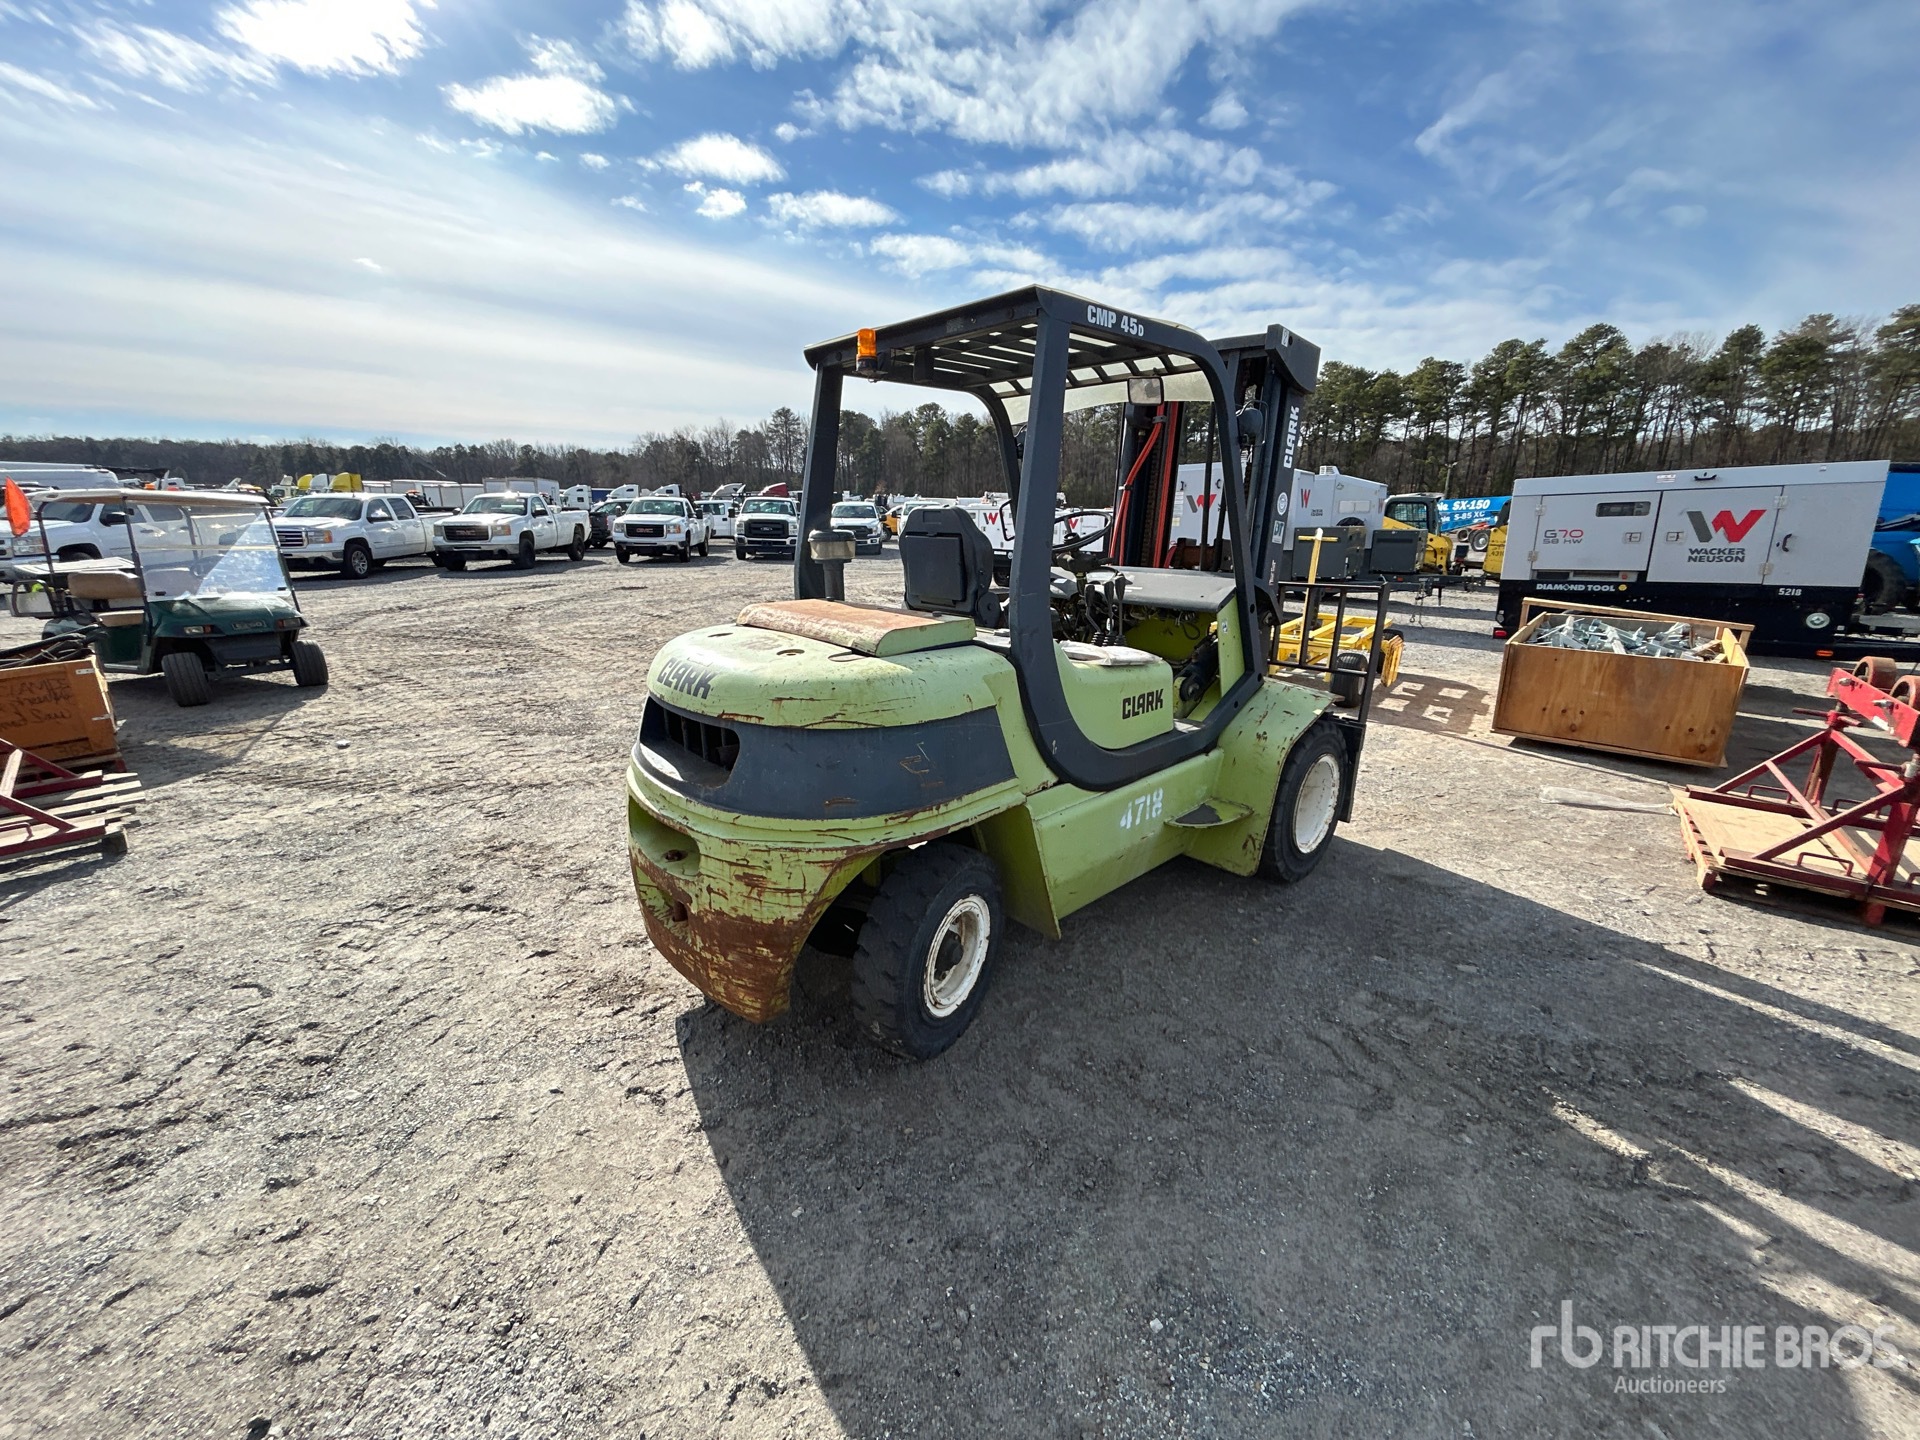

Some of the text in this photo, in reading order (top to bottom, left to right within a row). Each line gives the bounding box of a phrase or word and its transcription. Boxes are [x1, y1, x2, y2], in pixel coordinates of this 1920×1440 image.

[1087, 304, 1117, 328] CMP
[1283, 405, 1300, 469] CLARK
[1453, 500, 1490, 510] SX-150
[1544, 529, 1584, 539] G70
[1688, 547, 1746, 556] WACKER
[1687, 555, 1746, 563] NEUSON
[1536, 583, 1616, 592] DIAMOND TOOL
[1778, 587, 1802, 596] 5218
[657, 657, 720, 699] CLARK
[1122, 688, 1164, 720] CLARK
[1120, 787, 1164, 829] 4718
